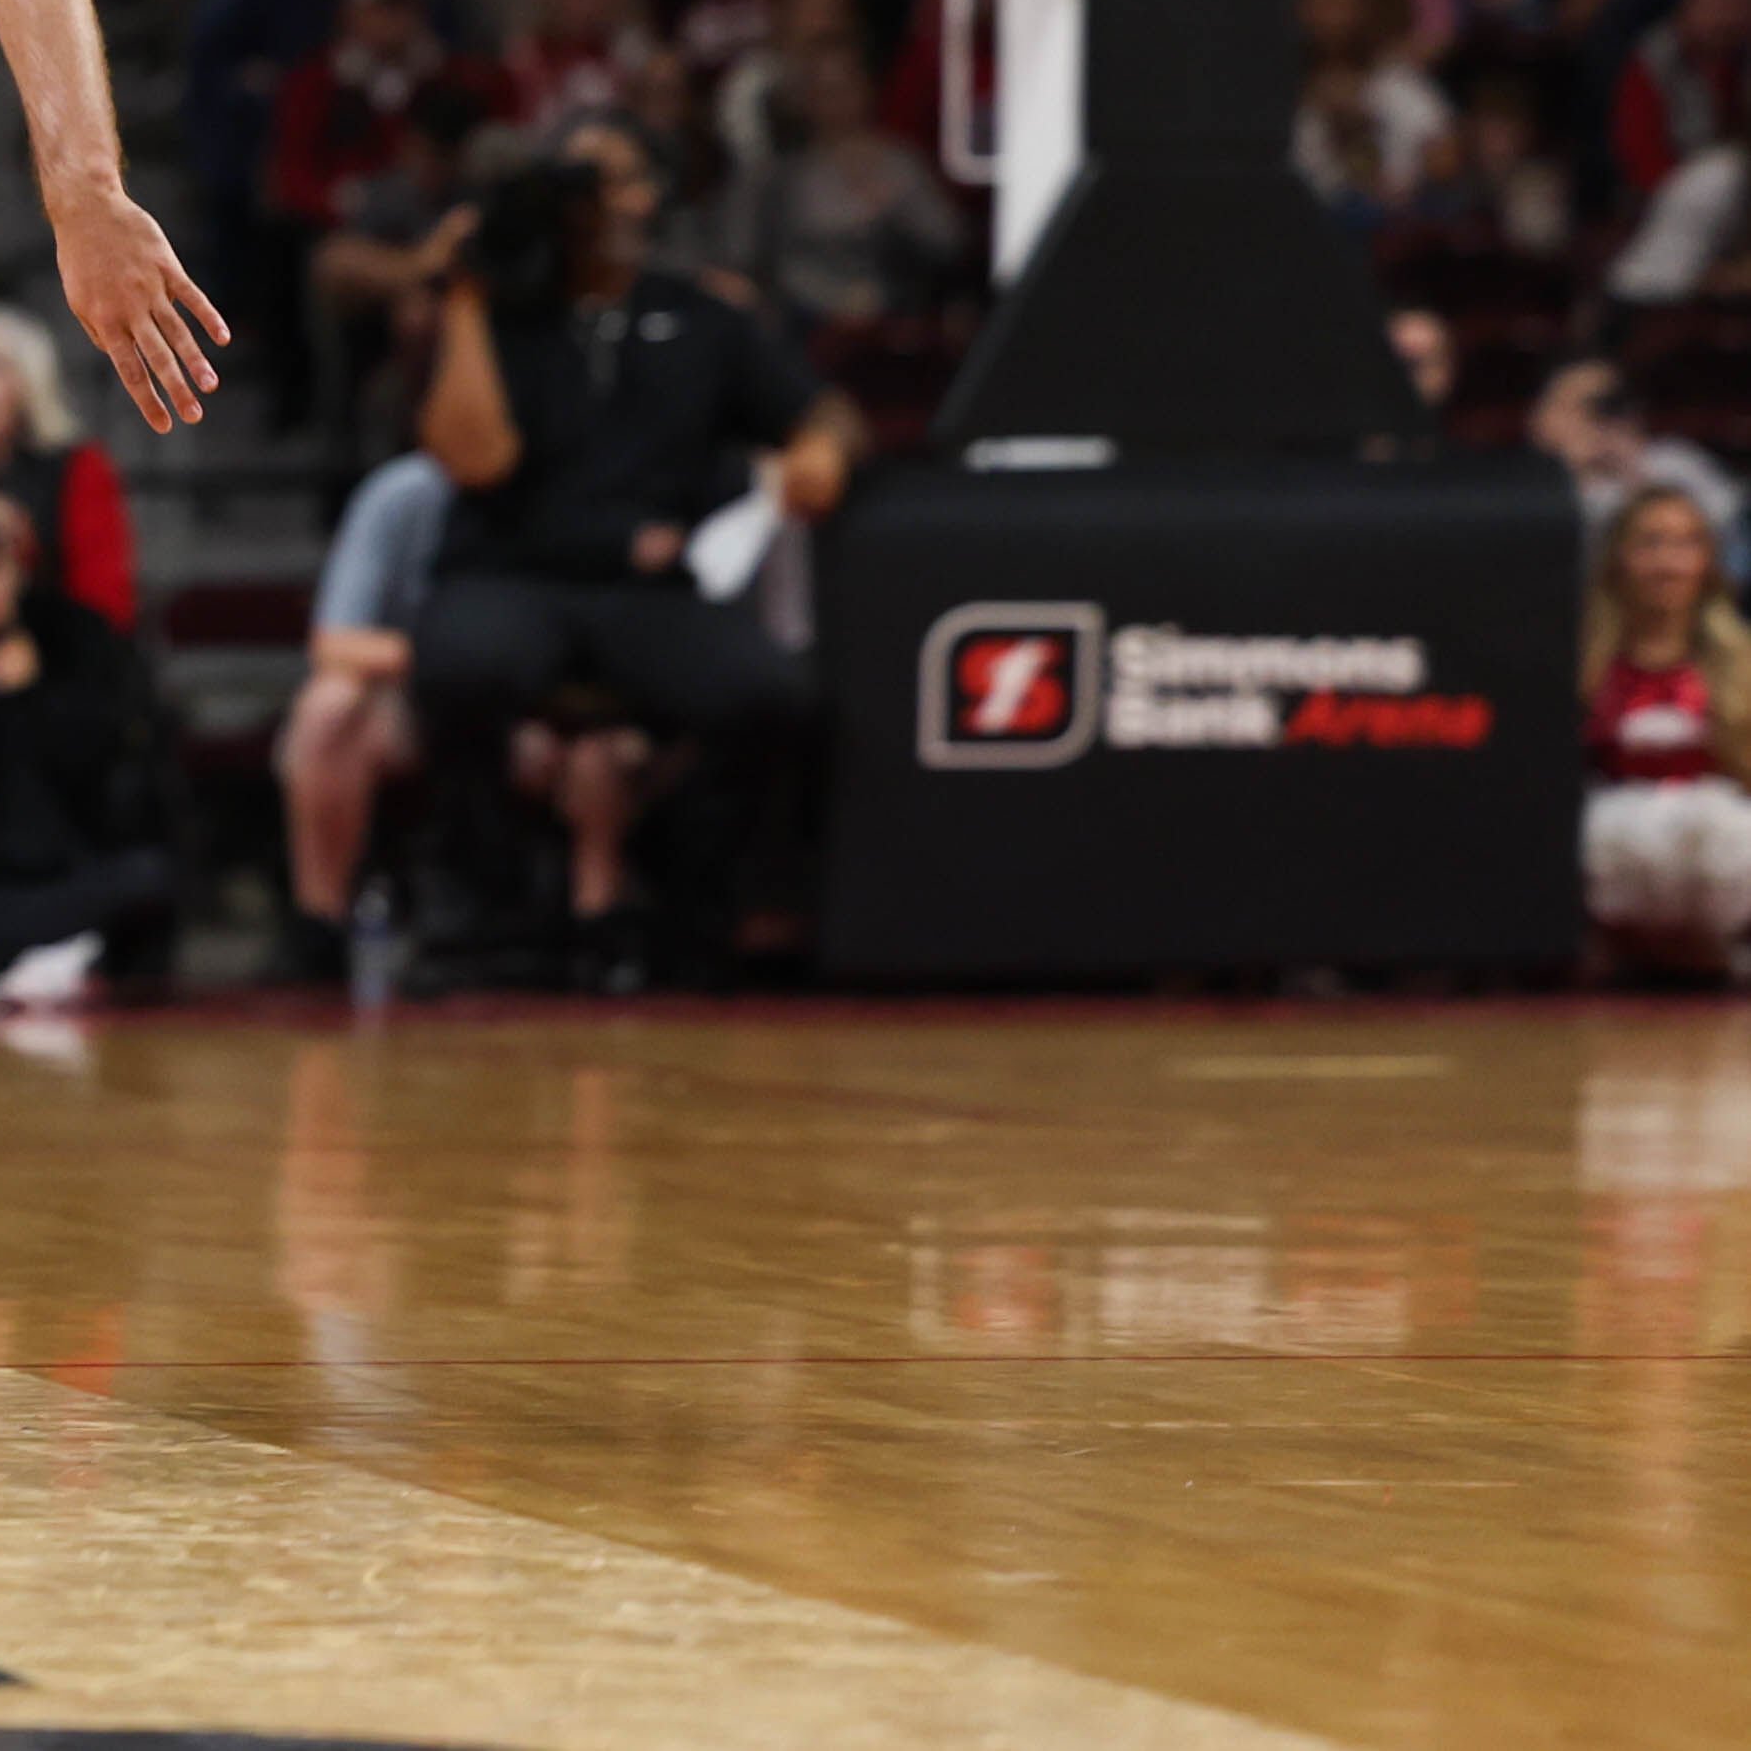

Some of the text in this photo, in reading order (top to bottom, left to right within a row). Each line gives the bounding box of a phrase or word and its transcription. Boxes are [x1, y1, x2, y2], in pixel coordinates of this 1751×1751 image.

[1108, 623, 1427, 693] Simmons
[1107, 686, 1492, 748] Bank Arena
